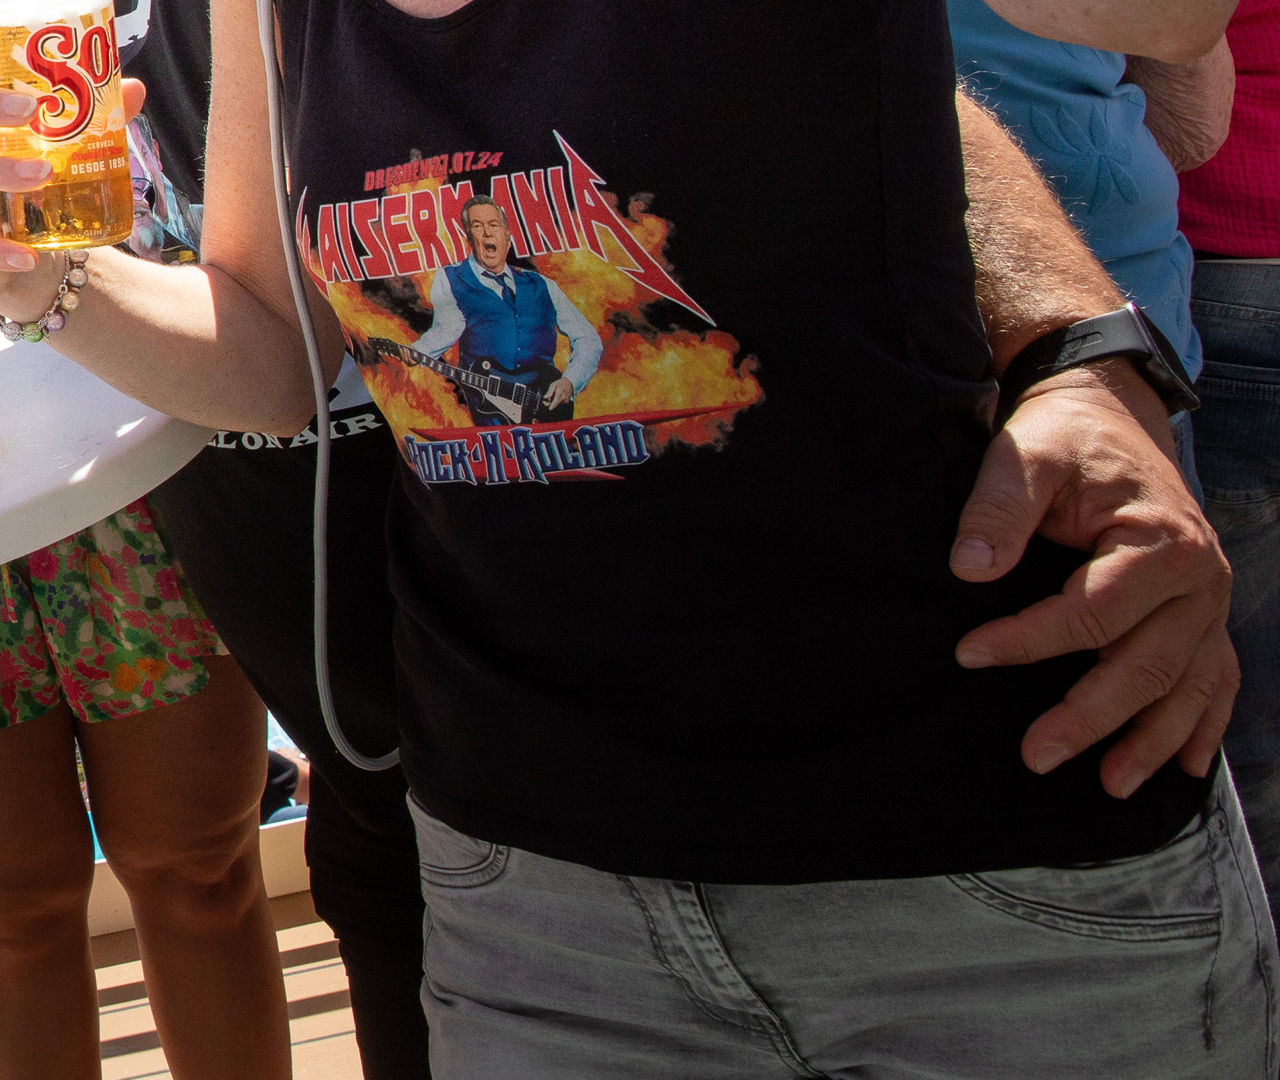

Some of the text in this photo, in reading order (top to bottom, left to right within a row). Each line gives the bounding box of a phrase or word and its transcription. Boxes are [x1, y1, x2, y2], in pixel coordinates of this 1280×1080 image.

[70, 160, 106, 175] DESDE
[363, 157, 432, 192] DRESDEN
[241, 431, 284, 450] ON
[289, 412, 383, 448] AIR
